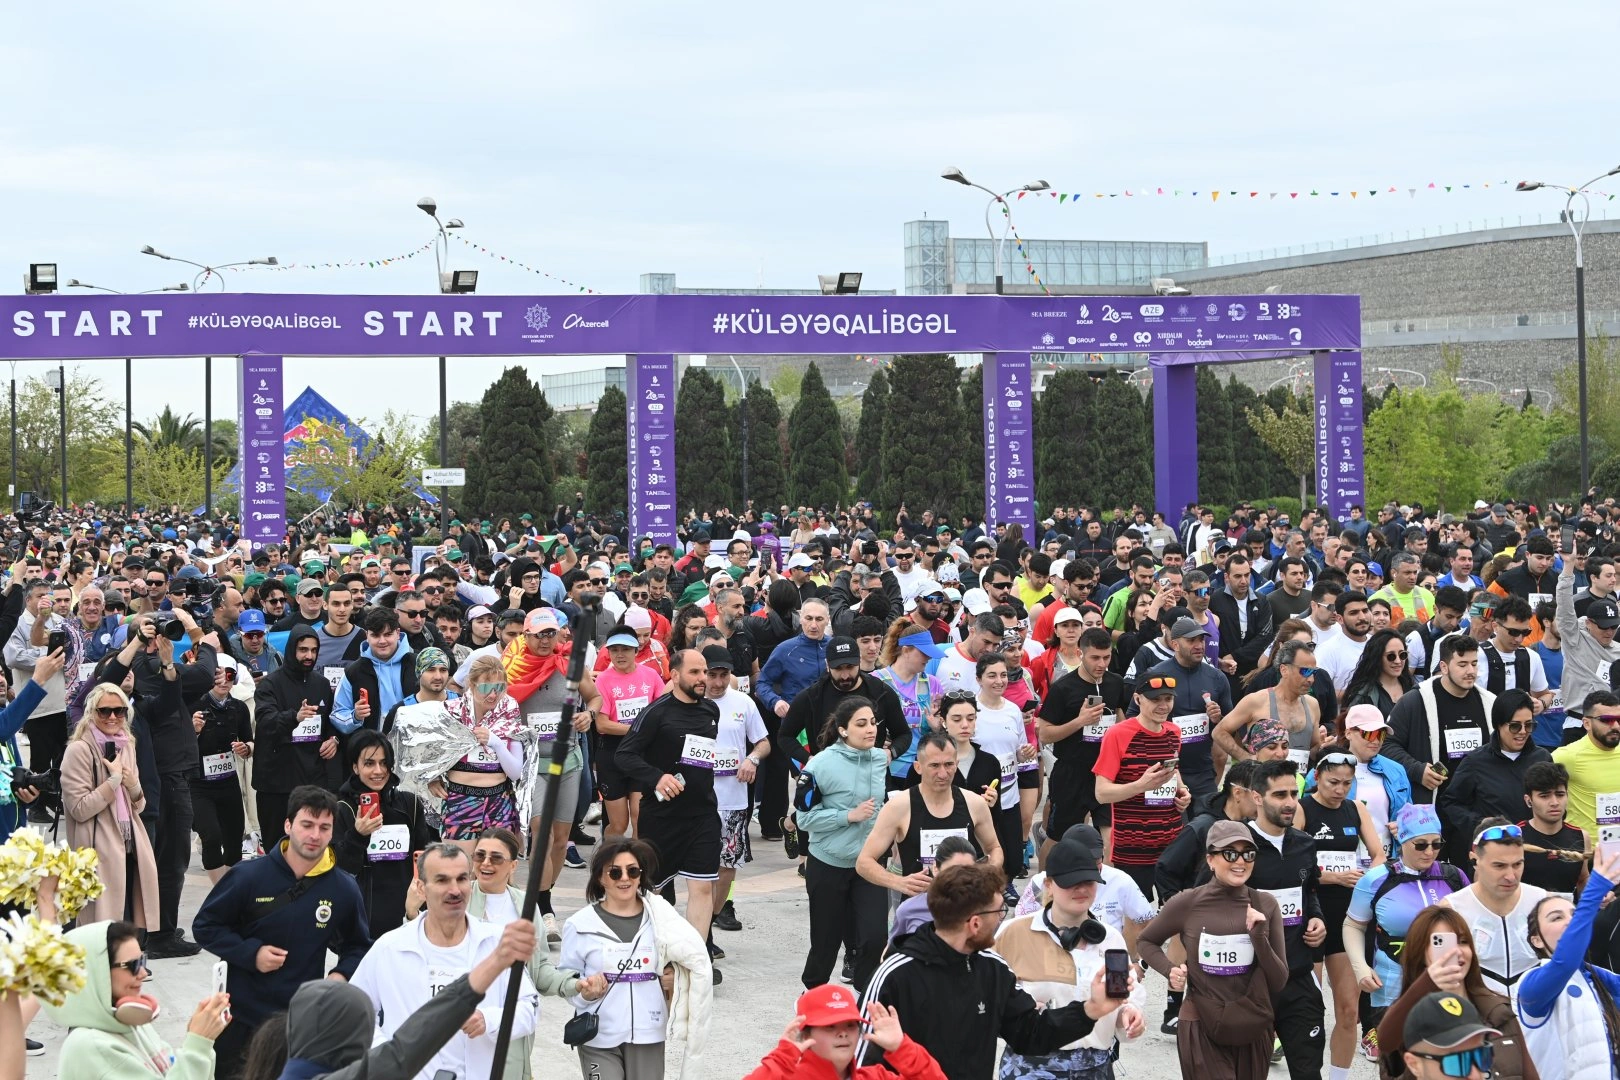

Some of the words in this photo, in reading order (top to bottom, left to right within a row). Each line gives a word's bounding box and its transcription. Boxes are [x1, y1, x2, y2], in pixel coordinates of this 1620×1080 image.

[13, 310, 163, 337] START
[188, 312, 342, 330] #KÜLƏYƏQALİBGƏL
[363, 310, 502, 337] START
[713, 308, 956, 337] #KÜLƏYƏQALİBGƏL
[302, 726, 316, 734] 758
[1182, 725, 1205, 735] 5383
[1451, 740, 1478, 750] 13505
[690, 748, 711, 760] 5672
[209, 762, 232, 774] 17988
[379, 840, 402, 850] 206
[1216, 952, 1237, 963] 118
[617, 959, 642, 971] 624
